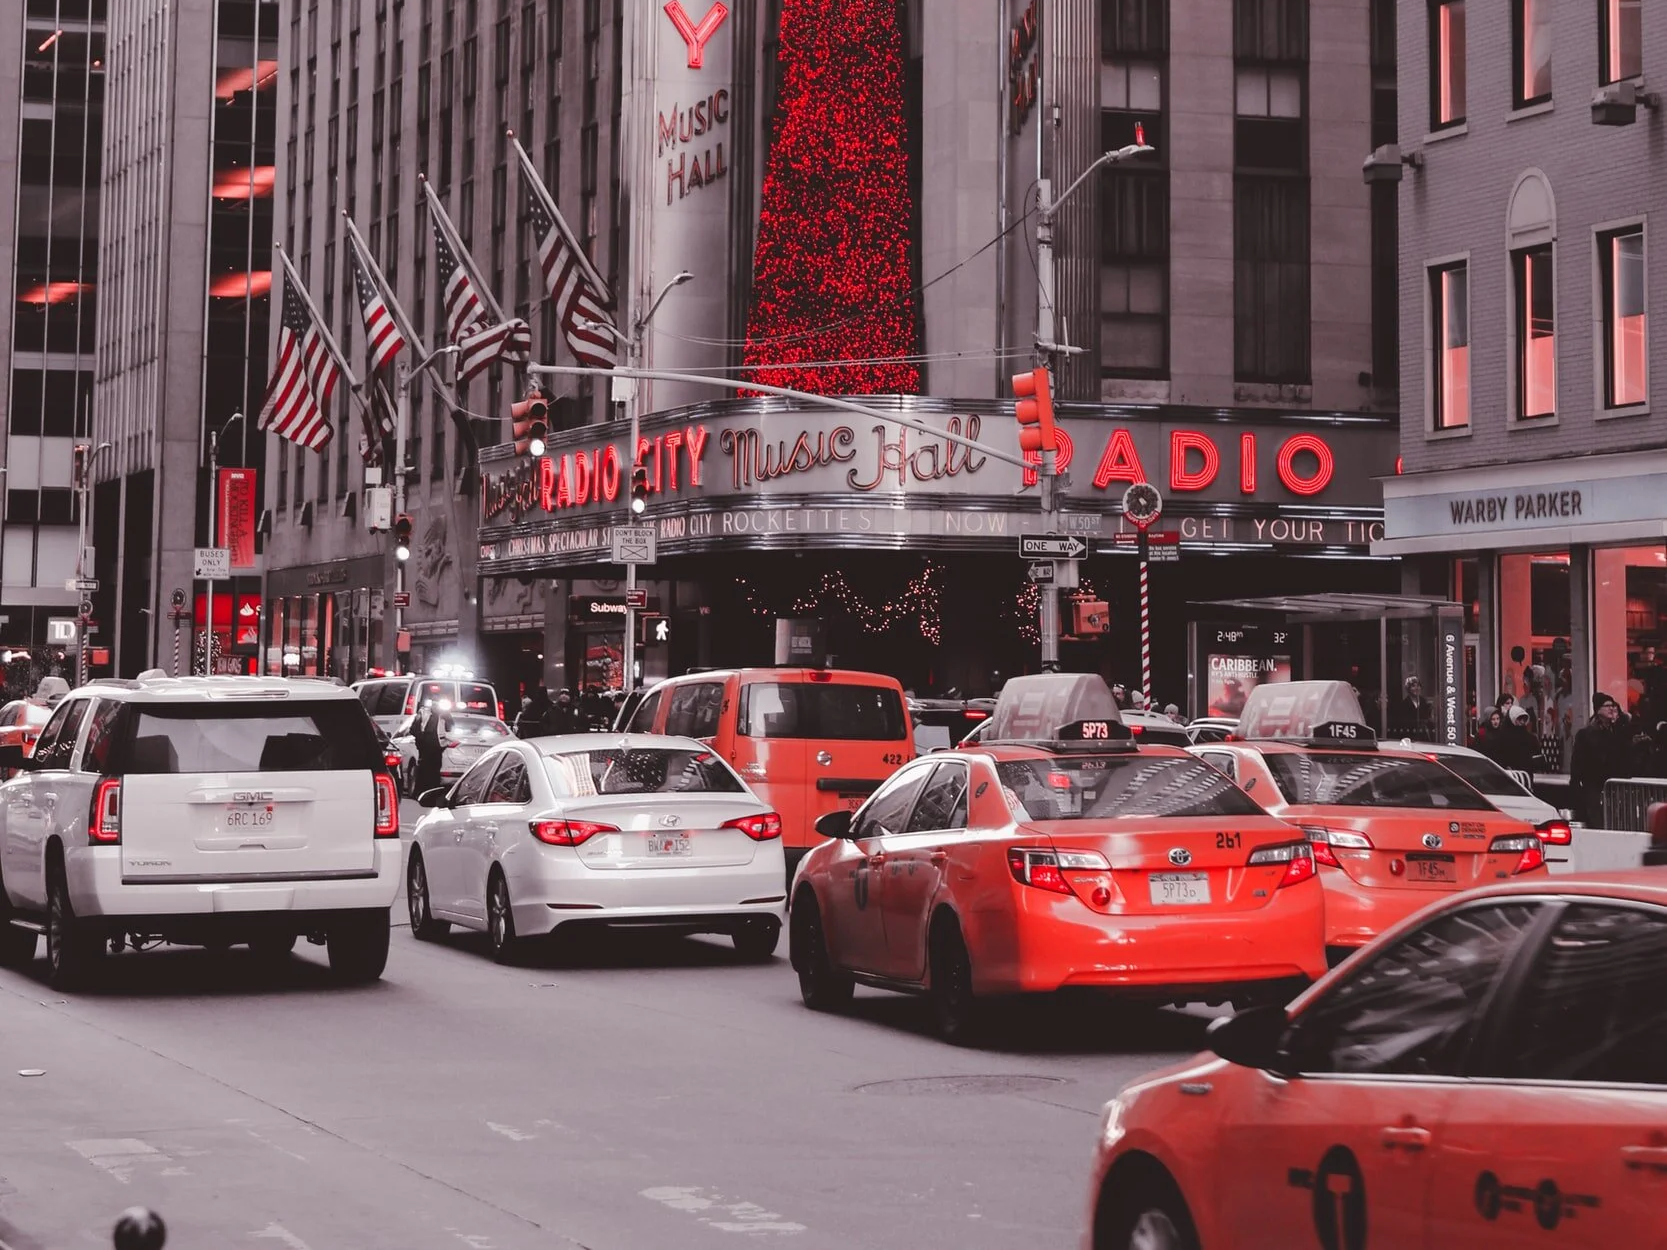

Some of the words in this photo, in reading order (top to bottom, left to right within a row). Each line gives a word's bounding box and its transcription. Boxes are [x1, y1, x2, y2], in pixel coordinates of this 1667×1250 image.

[657, 90, 730, 157] MUSIC
[667, 143, 729, 206] HALL
[721, 426, 857, 490] Music
[847, 414, 987, 492] Hall
[541, 444, 620, 512] RADIO
[636, 426, 707, 492] CITY
[1450, 499, 1508, 525] WARBY
[1515, 491, 1582, 519] PARKER
[660, 517, 686, 539] RADIO
[690, 513, 713, 536] CITY
[722, 508, 873, 534] ROCKETTES
[945, 513, 1006, 534] NOW
[1181, 517, 1229, 540] GET
[1253, 519, 1324, 542] YOUR
[200, 550, 224, 558] BUSES
[1026, 542, 1047, 550] ONE
[1059, 541, 1080, 551] WAY
[590, 602, 627, 614] Subway
[50, 621, 76, 639] TD
[1446, 644, 1455, 683] Avenue
[1446, 686, 1456, 694] &
[1447, 697, 1456, 724] West
[1082, 722, 1109, 739] 5P73
[1329, 724, 1356, 738] 1F45
[1447, 726, 1456, 740] 50
[882, 753, 903, 764] 422
[233, 791, 274, 801] GMC
[227, 812, 249, 826] 6RC
[252, 812, 273, 826] 169
[1215, 832, 1242, 849] 261
